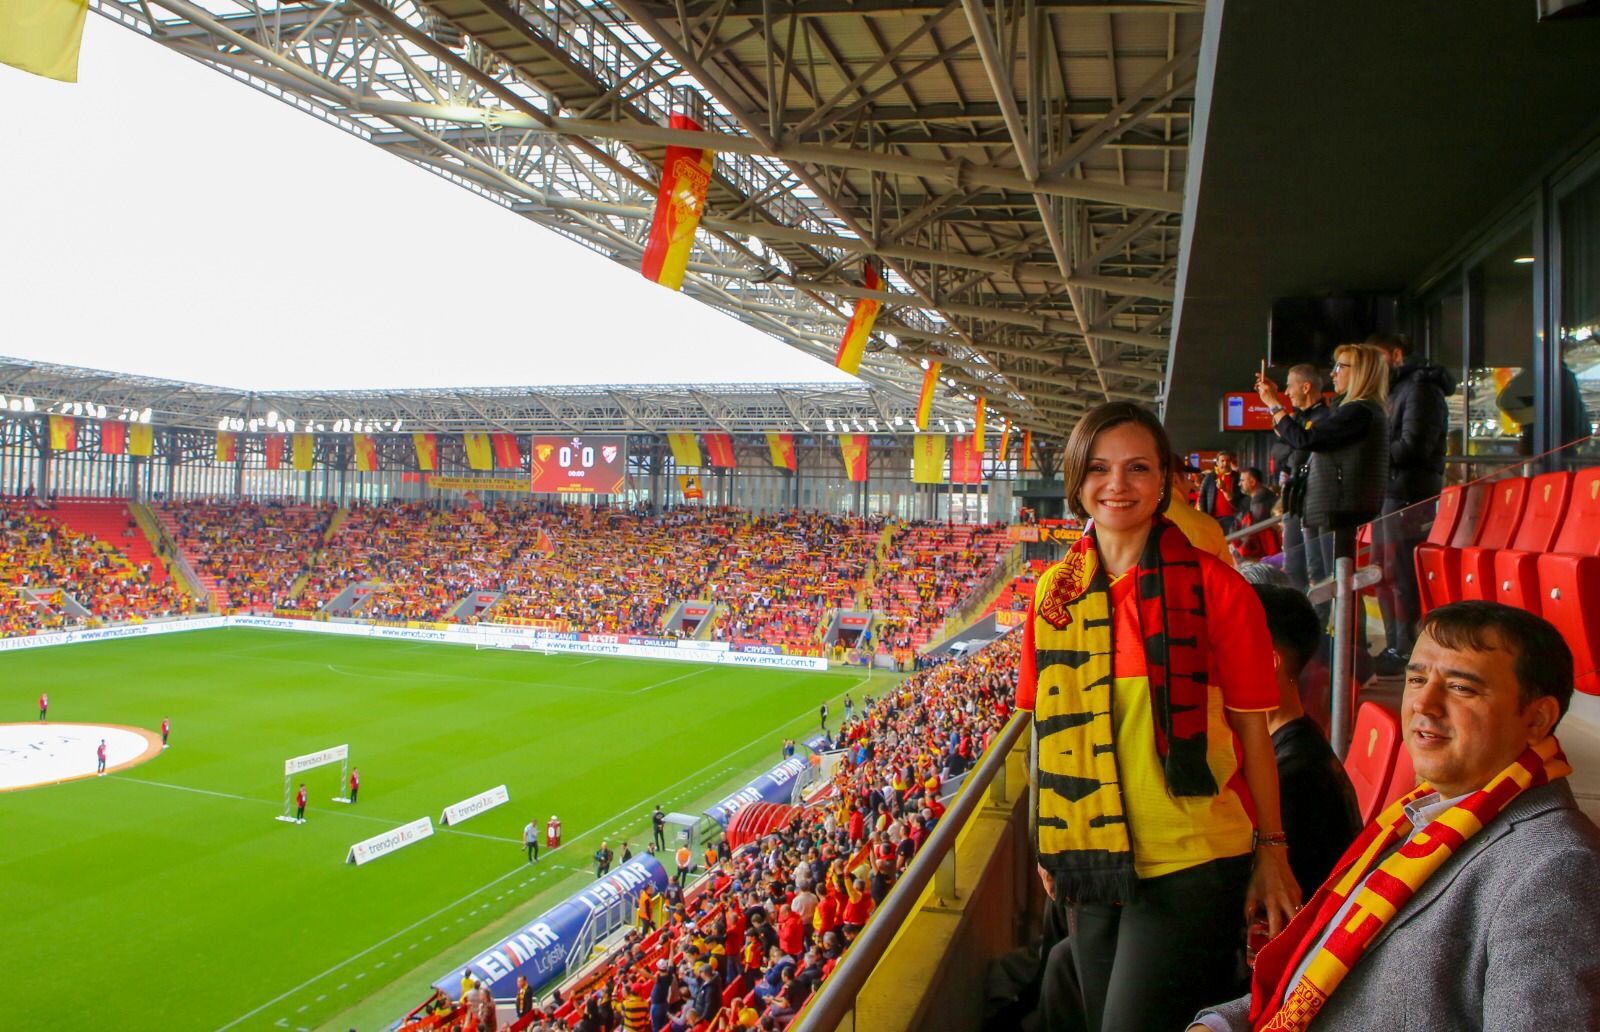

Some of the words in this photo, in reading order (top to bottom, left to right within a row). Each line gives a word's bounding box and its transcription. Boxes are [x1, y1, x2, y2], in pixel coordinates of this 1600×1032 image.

[559, 447, 571, 467] 0
[582, 447, 594, 467] 0
[81, 626, 149, 639] www.emot.com.tr
[382, 630, 446, 639] www.emot.com.tr
[546, 642, 619, 652] www.emot.com.tr
[734, 655, 816, 667] www.emot.com.tr
[369, 832, 399, 855] trendyol
